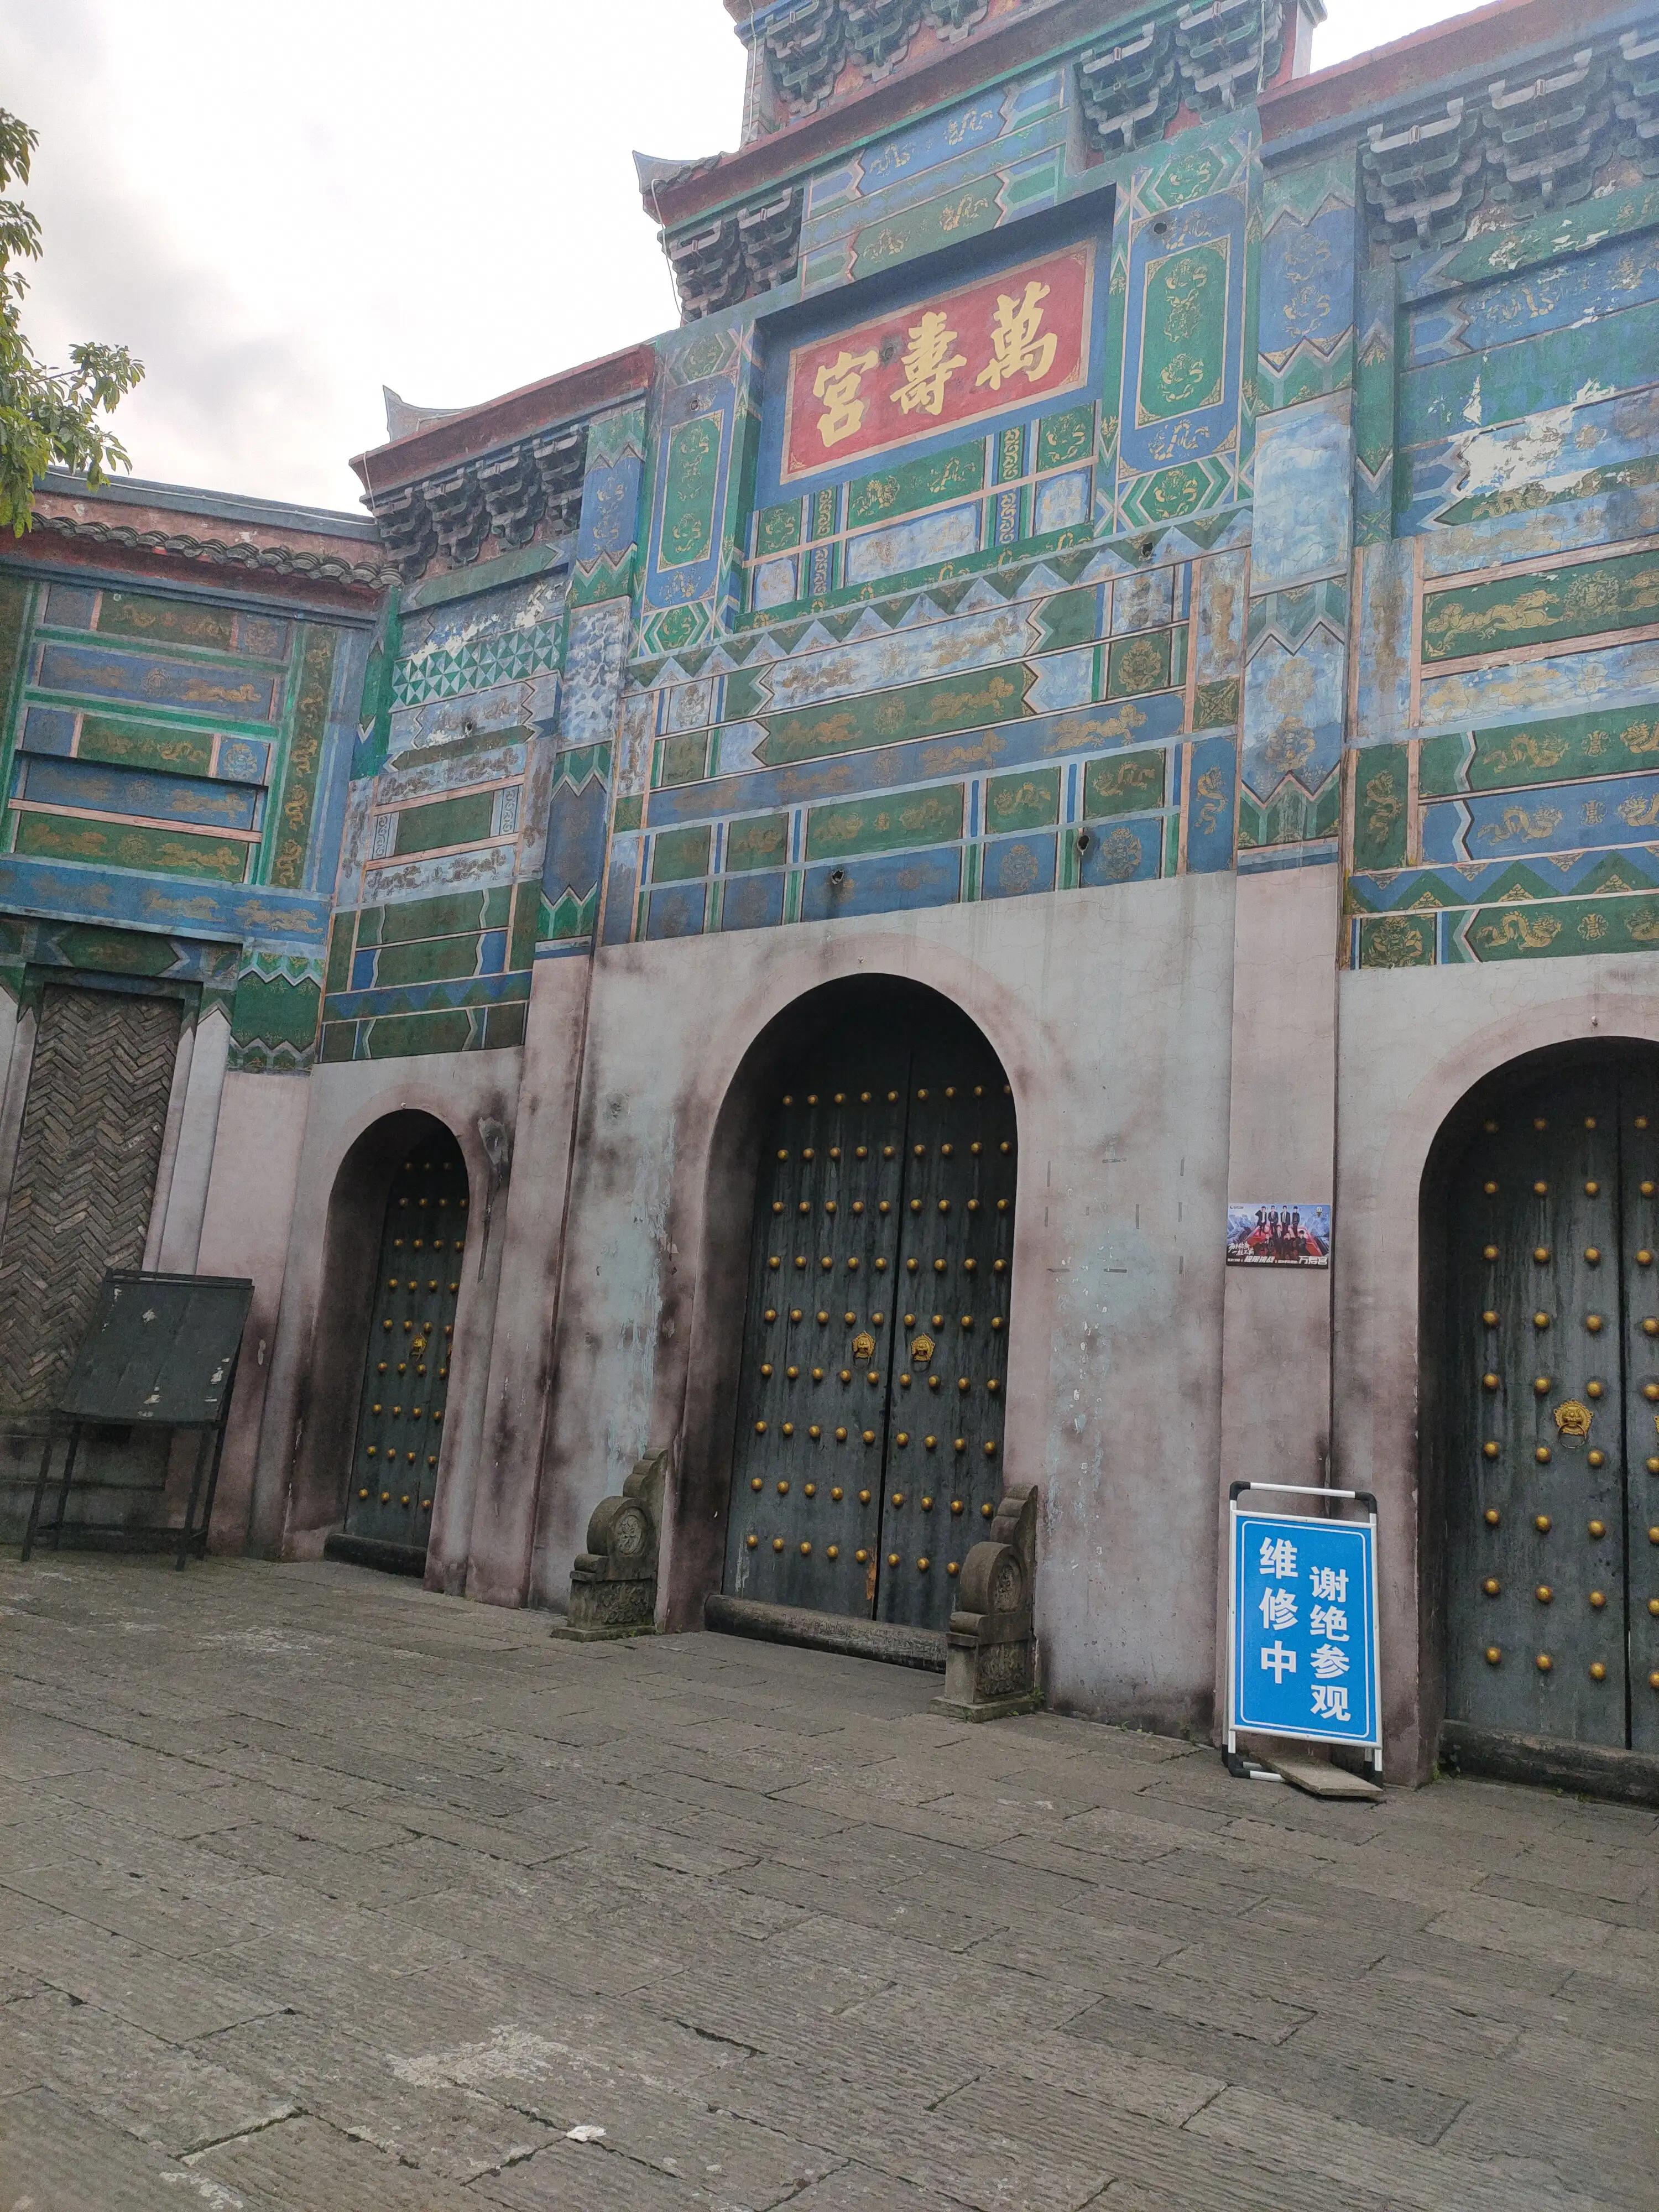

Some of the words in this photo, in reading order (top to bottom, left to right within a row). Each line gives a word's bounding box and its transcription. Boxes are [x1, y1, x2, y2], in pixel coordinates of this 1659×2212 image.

[1259, 1537, 1298, 1684] 维修中
[1309, 1566, 1351, 1721] 谢绝参观
